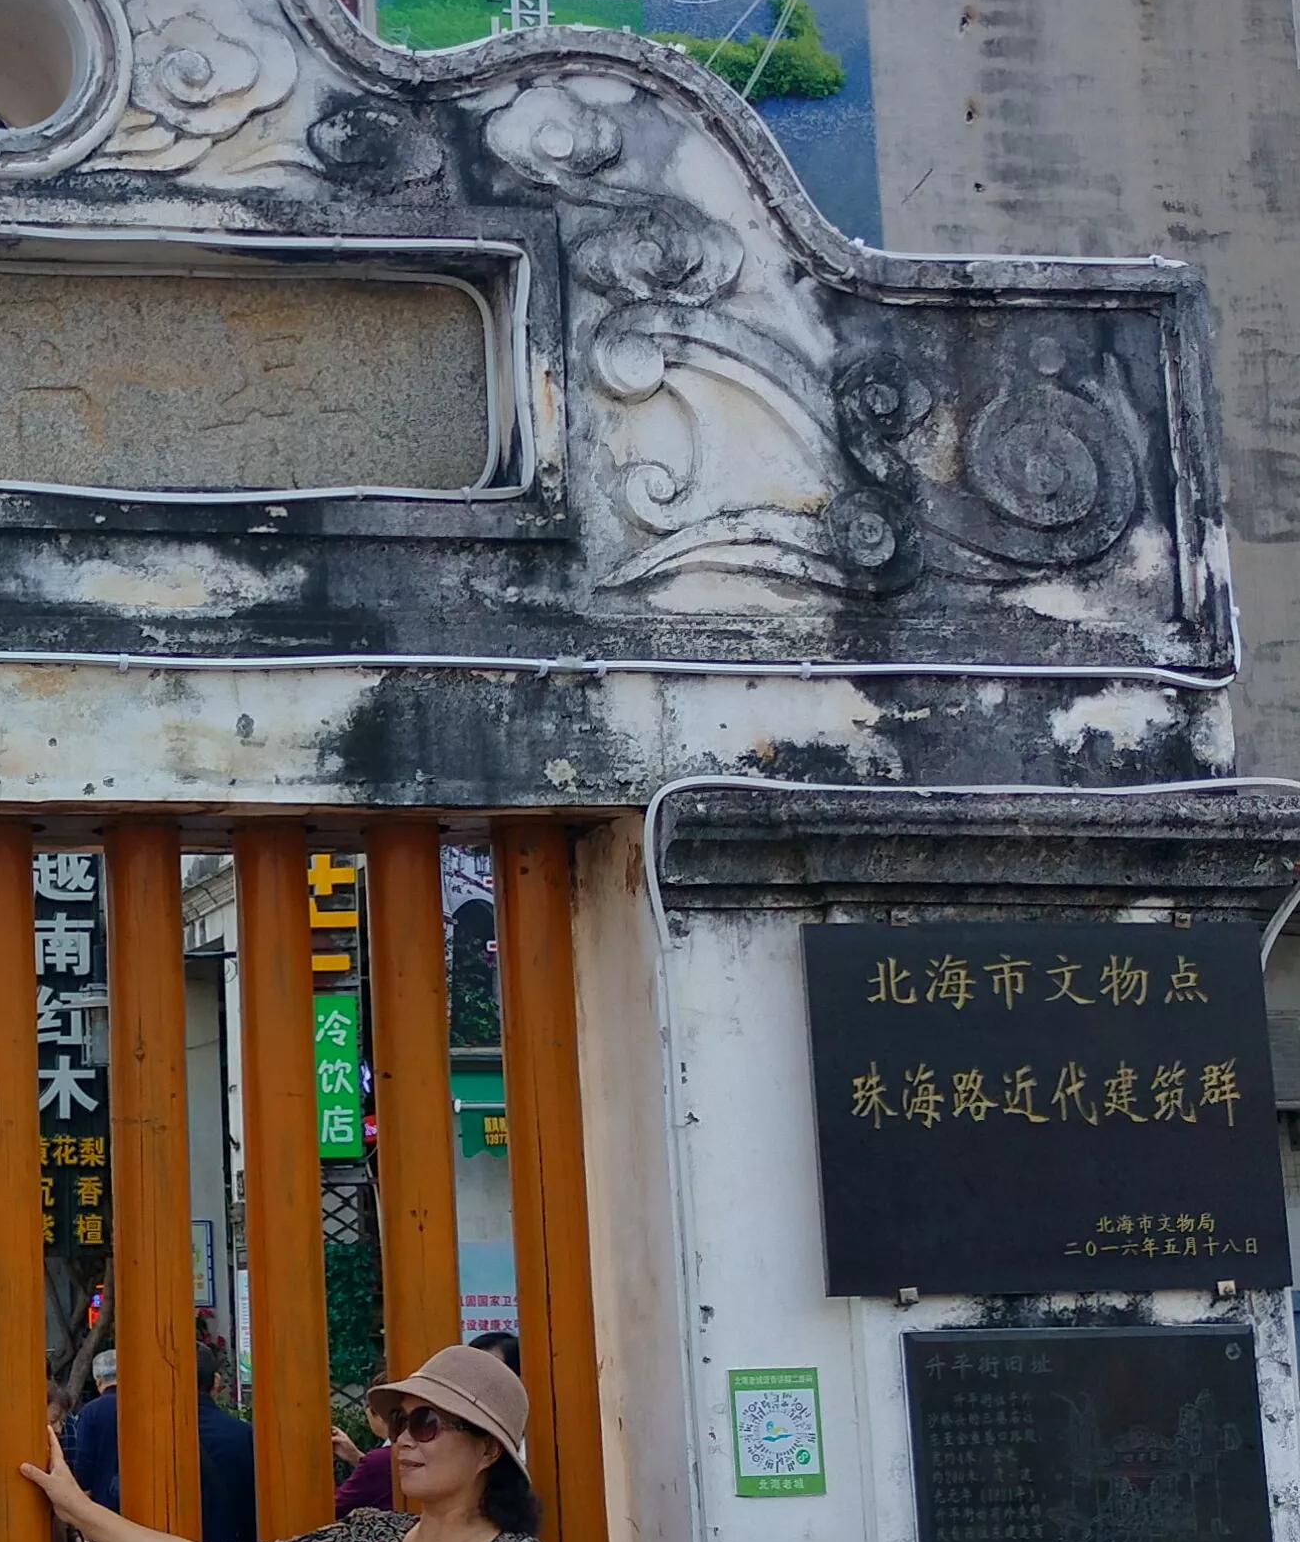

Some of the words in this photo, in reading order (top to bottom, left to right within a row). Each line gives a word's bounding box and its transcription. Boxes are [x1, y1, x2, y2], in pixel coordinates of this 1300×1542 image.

[34, 853, 99, 1119] 越南红木
[867, 955, 1208, 1011] 北海市文物点
[315, 1010, 354, 1143] 冷饮店
[851, 1057, 1242, 1130] 珠海路近代建筑群
[1096, 1213, 1215, 1235] 北海市文物局
[925, 1352, 1053, 1379] 升平街旧址
